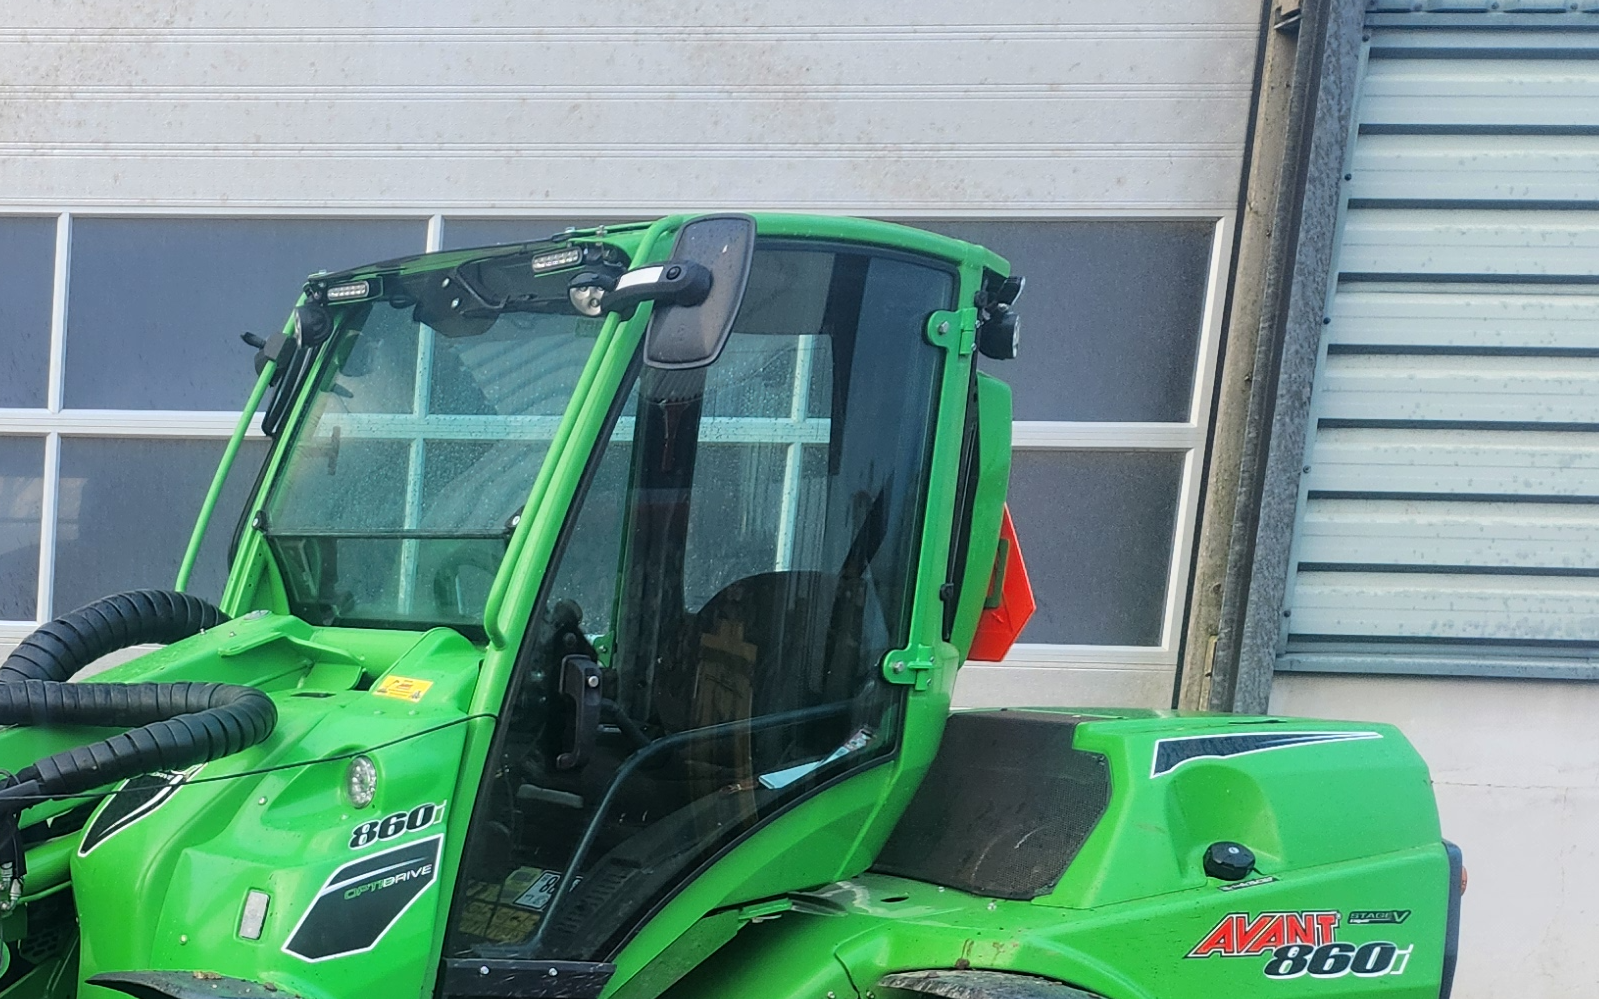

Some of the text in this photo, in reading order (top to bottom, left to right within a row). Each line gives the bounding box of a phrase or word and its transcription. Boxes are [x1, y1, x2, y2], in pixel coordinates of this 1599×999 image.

[348, 799, 447, 850] 860i
[343, 864, 433, 900] OPTIDRIVE
[1185, 910, 1341, 958] AVANT
[1263, 941, 1414, 979] 860i
